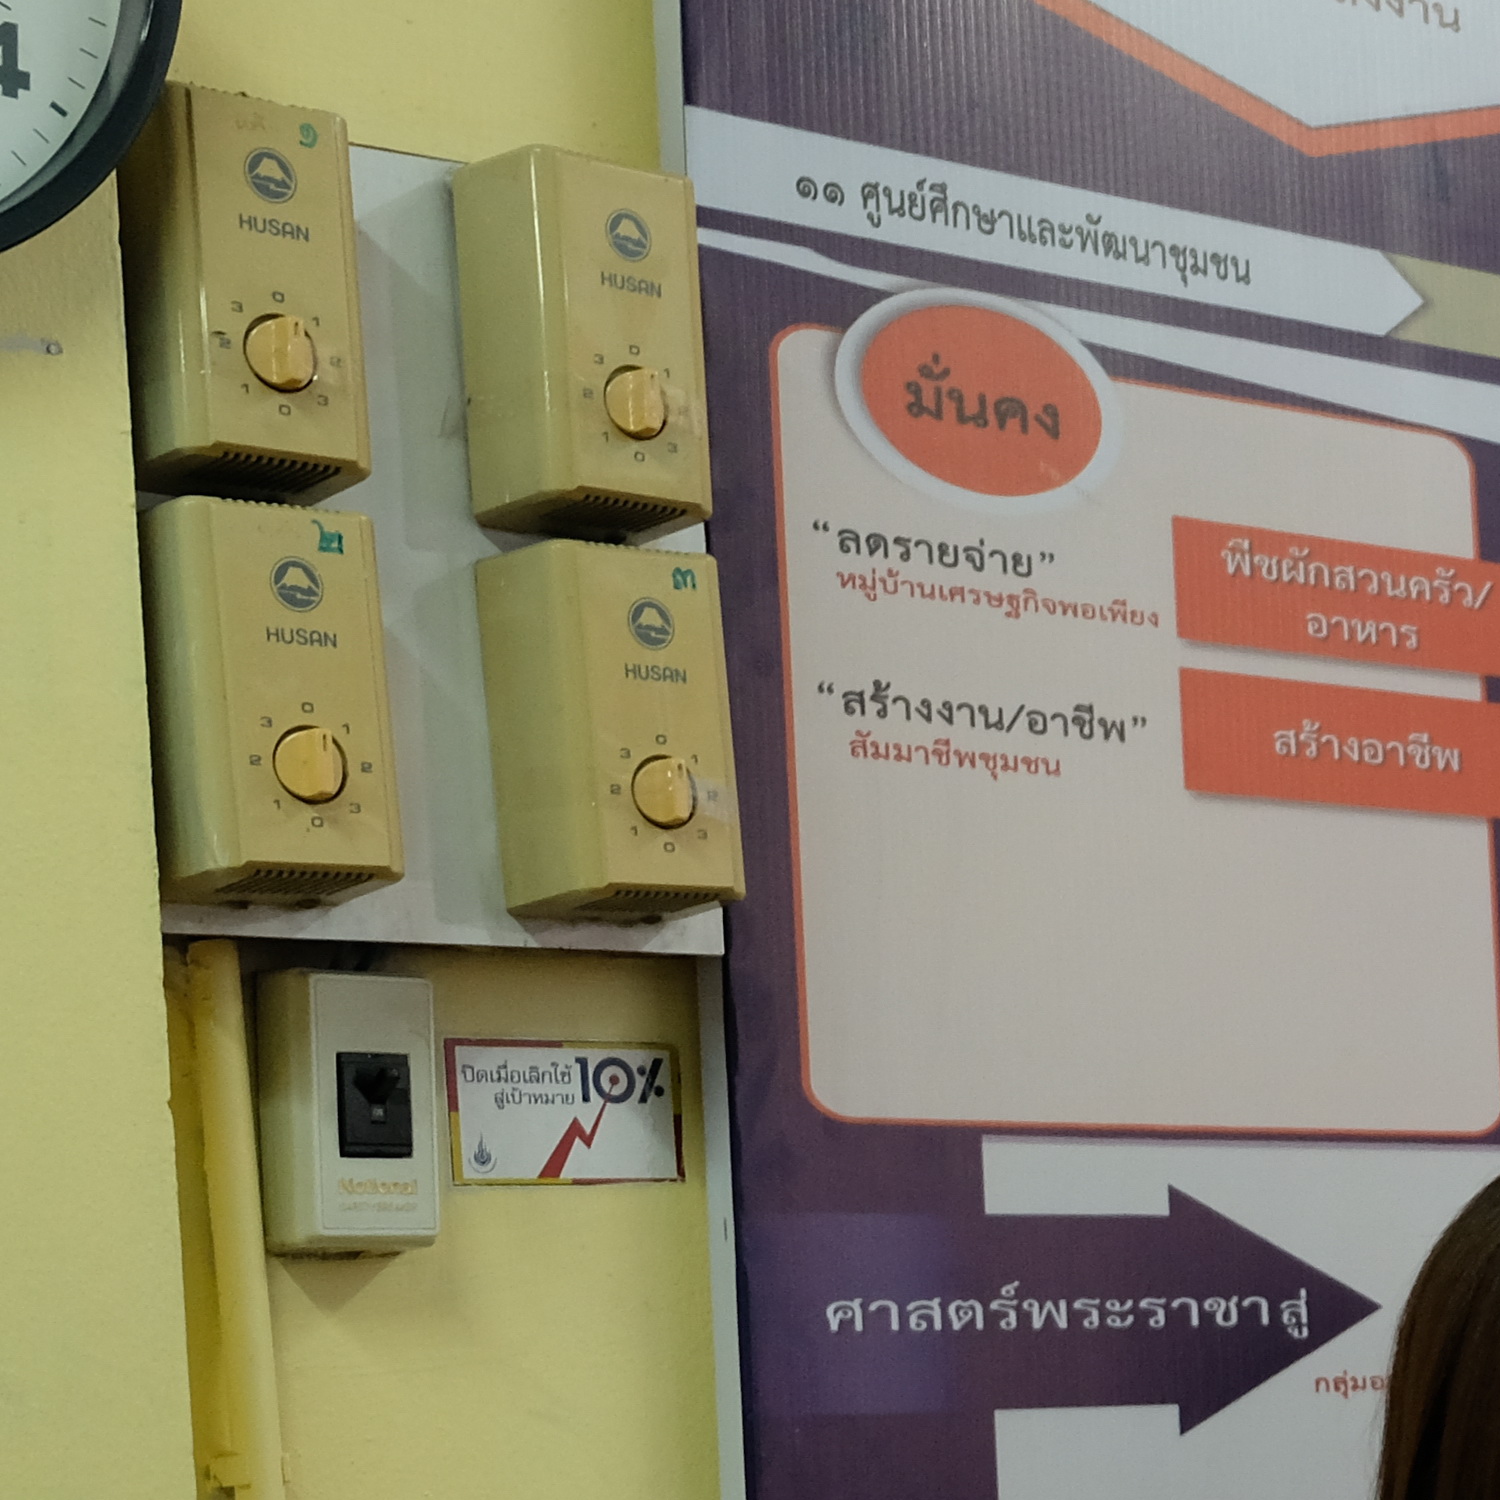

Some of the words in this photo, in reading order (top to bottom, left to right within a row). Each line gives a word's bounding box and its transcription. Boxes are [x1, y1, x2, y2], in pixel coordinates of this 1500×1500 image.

[238, 213, 311, 243] HUSAN
[795, 175, 846, 208] ๑๑
[861, 177, 1253, 289] ศูนย์ศึกษาและพัฒนาชุมชน
[600, 271, 662, 298] HUSAN
[904, 353, 1062, 441] มั่นคง
[836, 567, 1160, 629] หมู่บ้านเศรษฐกิจพอเพียง
[266, 626, 338, 649] HUSAN
[1306, 611, 1420, 651] อาหาร
[624, 662, 688, 684] HUSAN
[849, 730, 1062, 781] สัมมาชีพชุมชน
[1274, 719, 1462, 772] สร้างอาชีพ
[461, 1060, 573, 1086] ปิดเมื่อเลิกใช้
[575, 1056, 664, 1105] 10%
[494, 1088, 576, 1110] สู่เป้าหมาย
